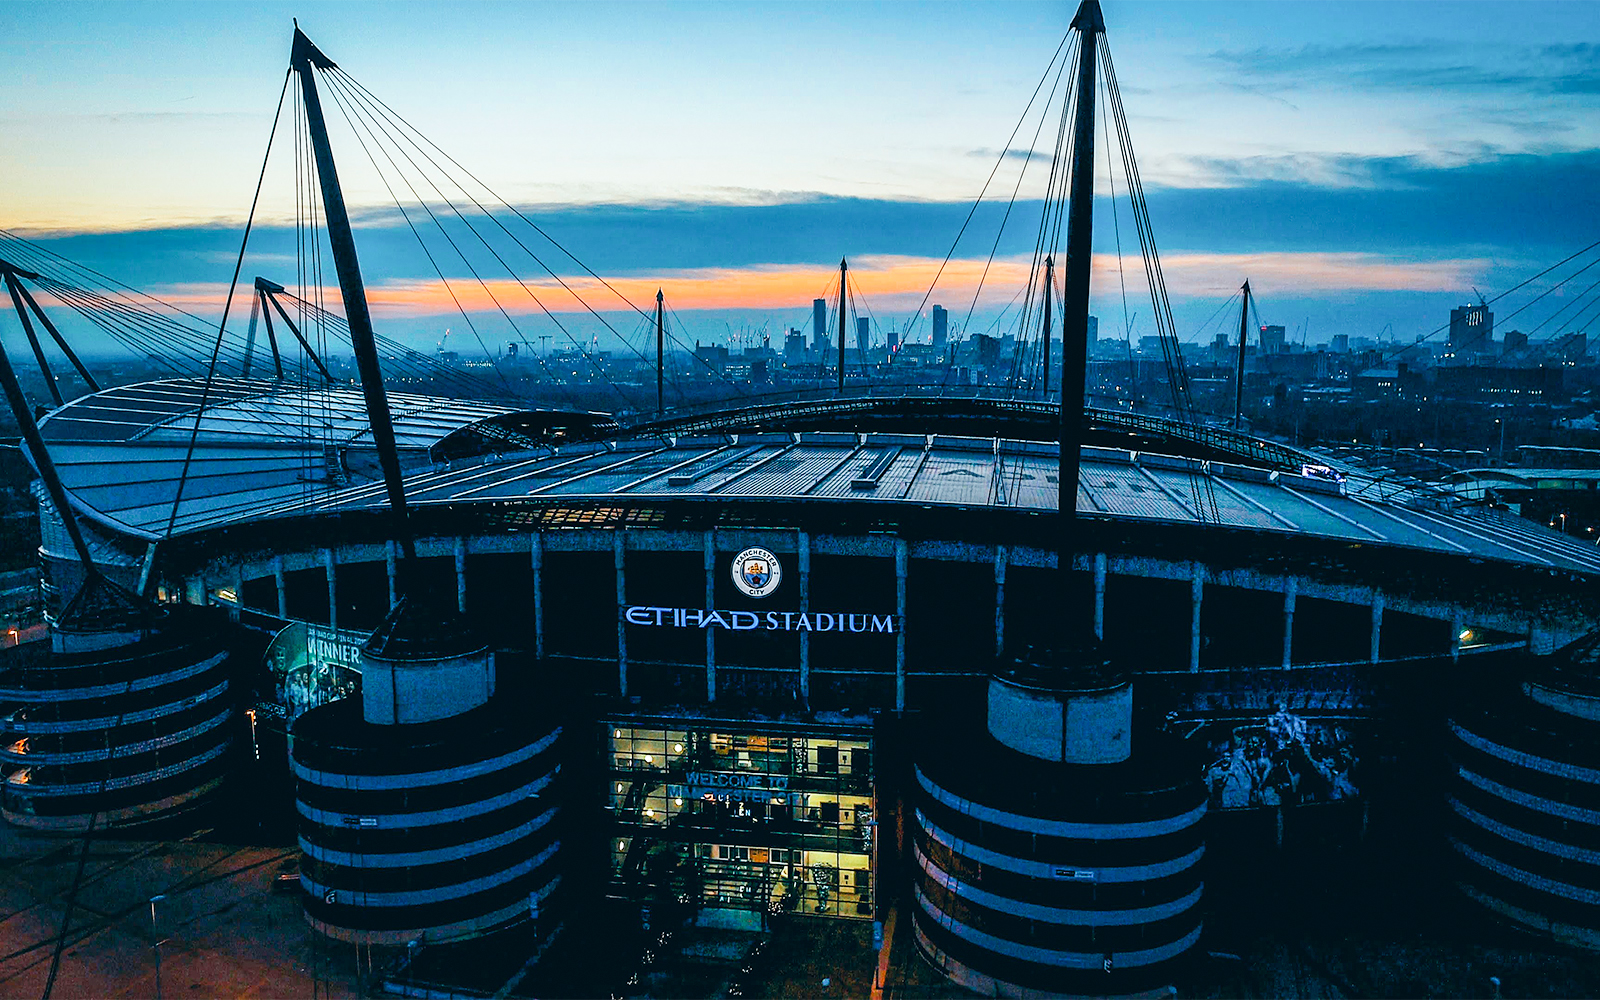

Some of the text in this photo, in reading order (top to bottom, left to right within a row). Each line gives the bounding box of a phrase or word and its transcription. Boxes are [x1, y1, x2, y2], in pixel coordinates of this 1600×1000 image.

[735, 549, 777, 567] MANCHESTER
[625, 606, 893, 633] ETIHAD STADIUM
[307, 636, 362, 665] WINNER
[685, 771, 789, 789] WELCOME TO
